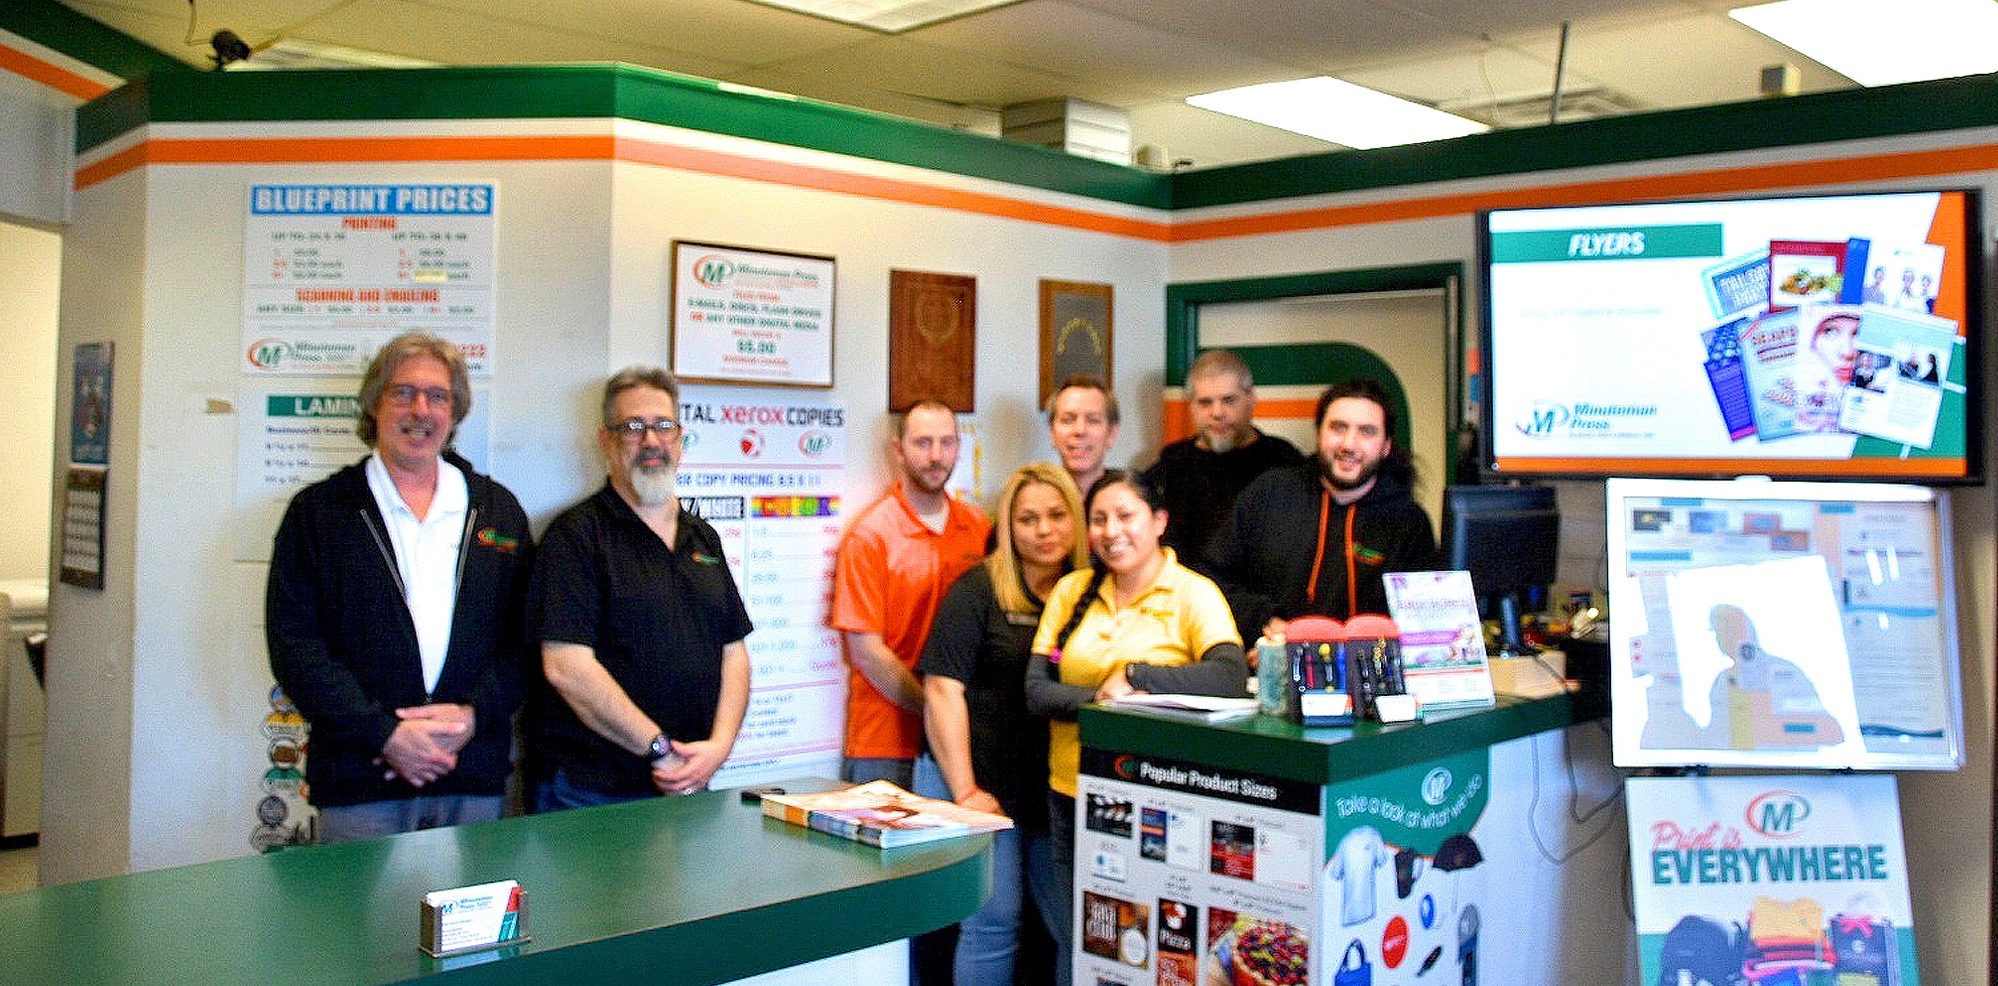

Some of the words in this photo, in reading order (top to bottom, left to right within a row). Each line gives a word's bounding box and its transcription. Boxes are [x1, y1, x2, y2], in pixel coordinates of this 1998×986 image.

[255, 187, 391, 212] BLUEPRINT
[396, 187, 488, 212] PRICES
[1568, 231, 1646, 257] FLYERS
[720, 404, 785, 425] xerox
[786, 407, 845, 427] COPIES
[1140, 761, 1188, 785] Popular
[1188, 769, 1240, 792] Product
[1240, 778, 1278, 799] Sizes
[1336, 795, 1369, 819] Take
[1650, 819, 1720, 850] Print
[1721, 828, 1743, 849] is
[1651, 844, 1889, 885] EVERYWHERE
